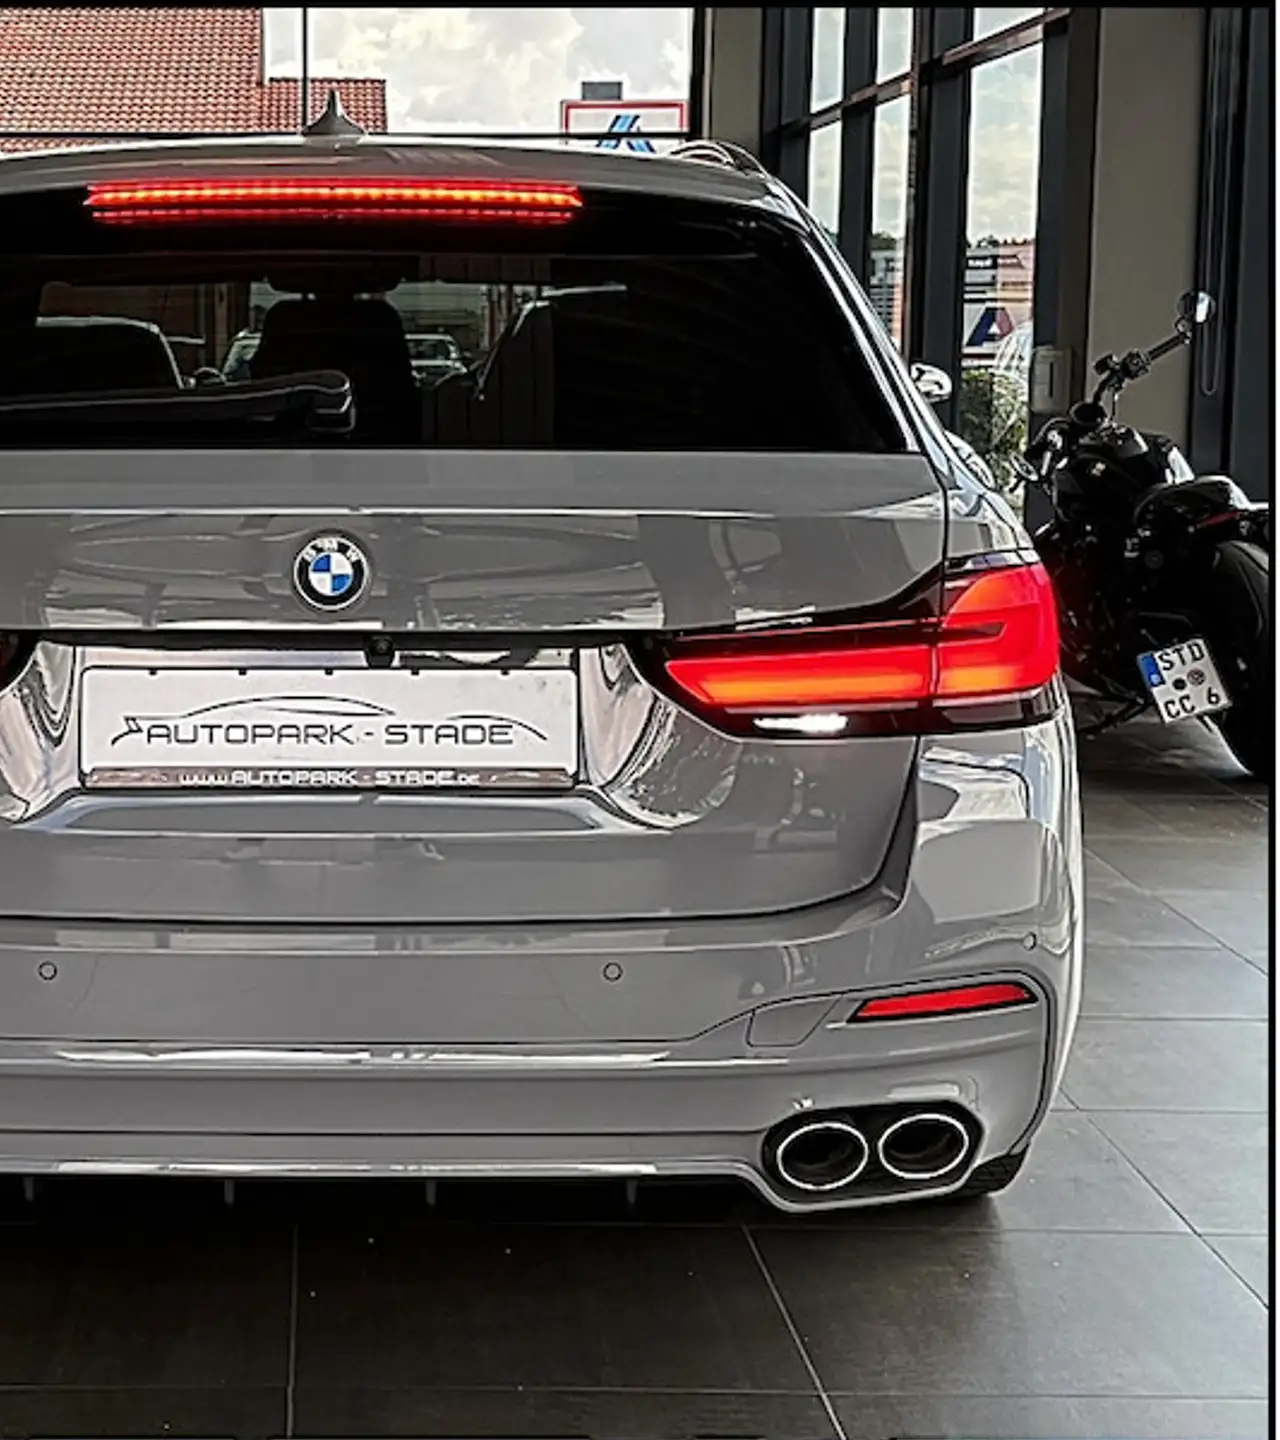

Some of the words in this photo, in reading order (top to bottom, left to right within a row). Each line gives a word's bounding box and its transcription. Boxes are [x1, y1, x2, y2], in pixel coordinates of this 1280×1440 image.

[1158, 642, 1205, 671] STD
[1164, 694, 1196, 718] CC
[1207, 686, 1220, 705] 6
[146, 724, 354, 745] AUTOPARK
[384, 724, 515, 745] STADE
